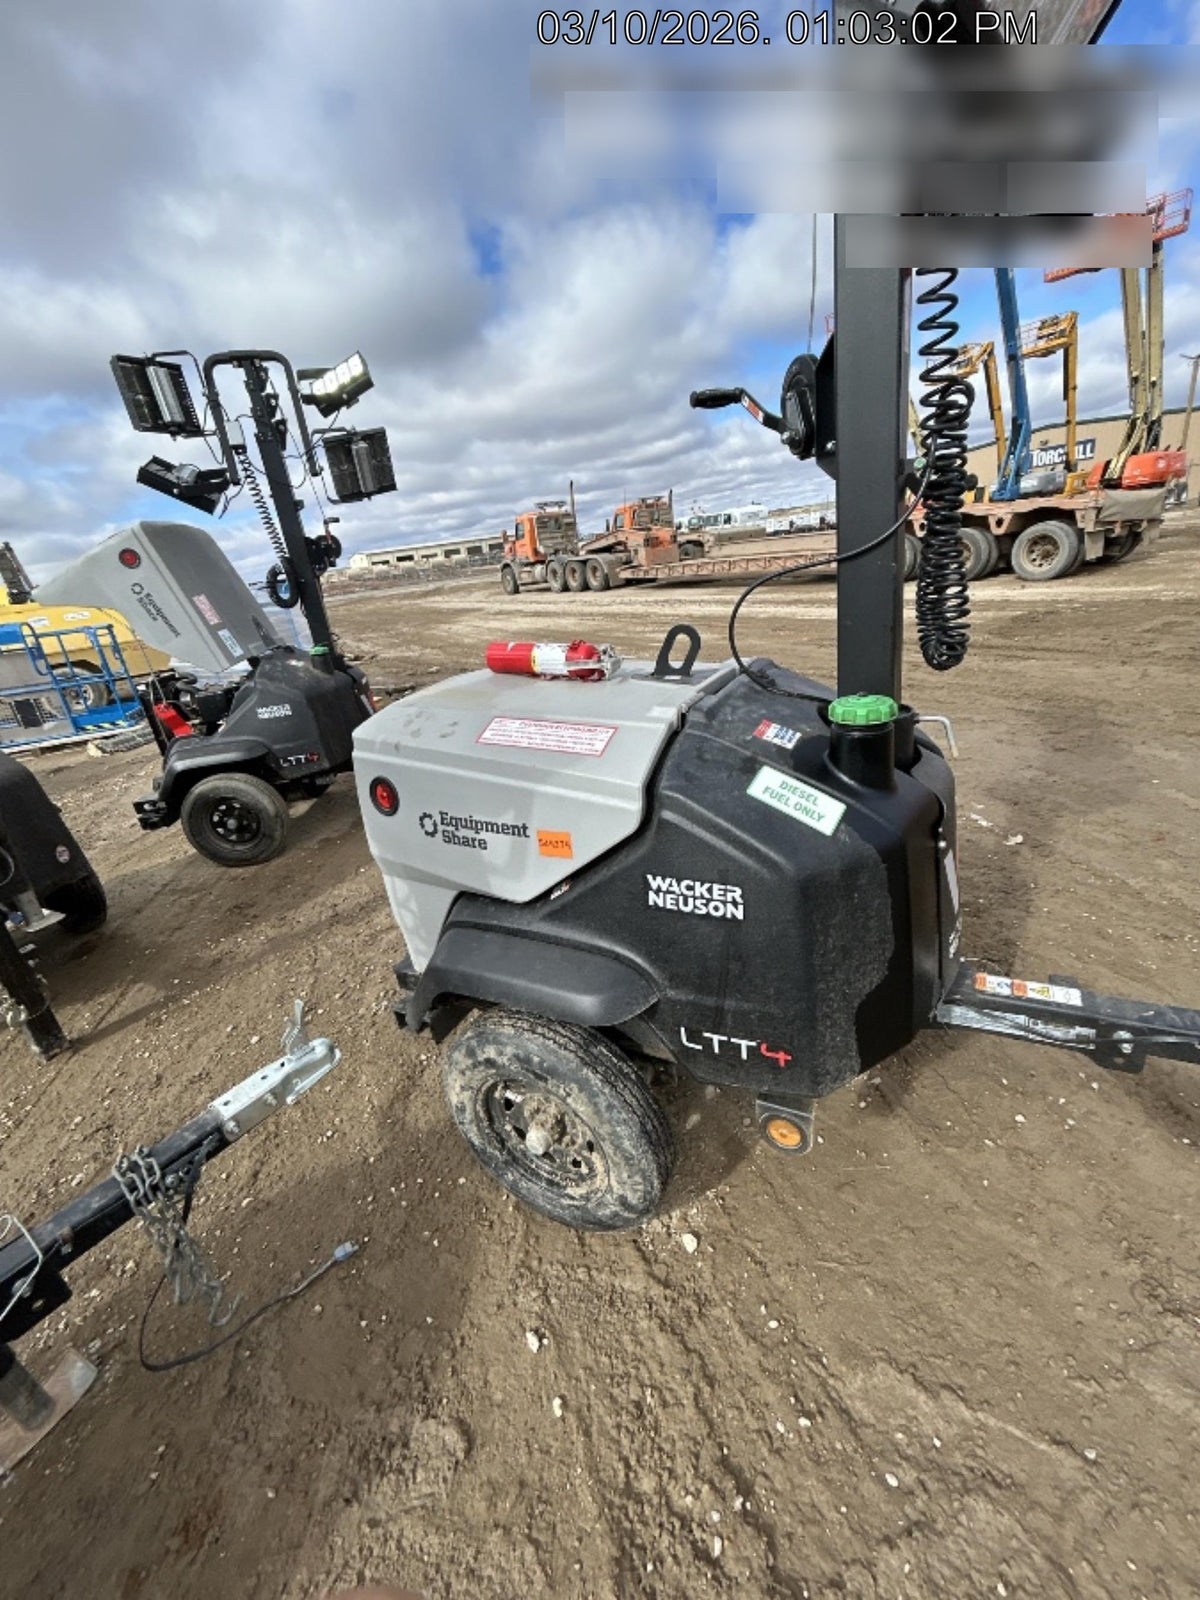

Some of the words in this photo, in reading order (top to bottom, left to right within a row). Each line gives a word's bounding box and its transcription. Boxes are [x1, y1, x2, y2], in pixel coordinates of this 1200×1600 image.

[762, 785, 791, 808] FUEL
[793, 801, 825, 823] ONLY
[779, 780, 819, 807] DIESEL
[439, 811, 530, 838] Equipment
[442, 829, 488, 850] Share
[646, 874, 743, 903] WACKER
[648, 890, 744, 920] NEUSON
[680, 1027, 792, 1067] LTT4
